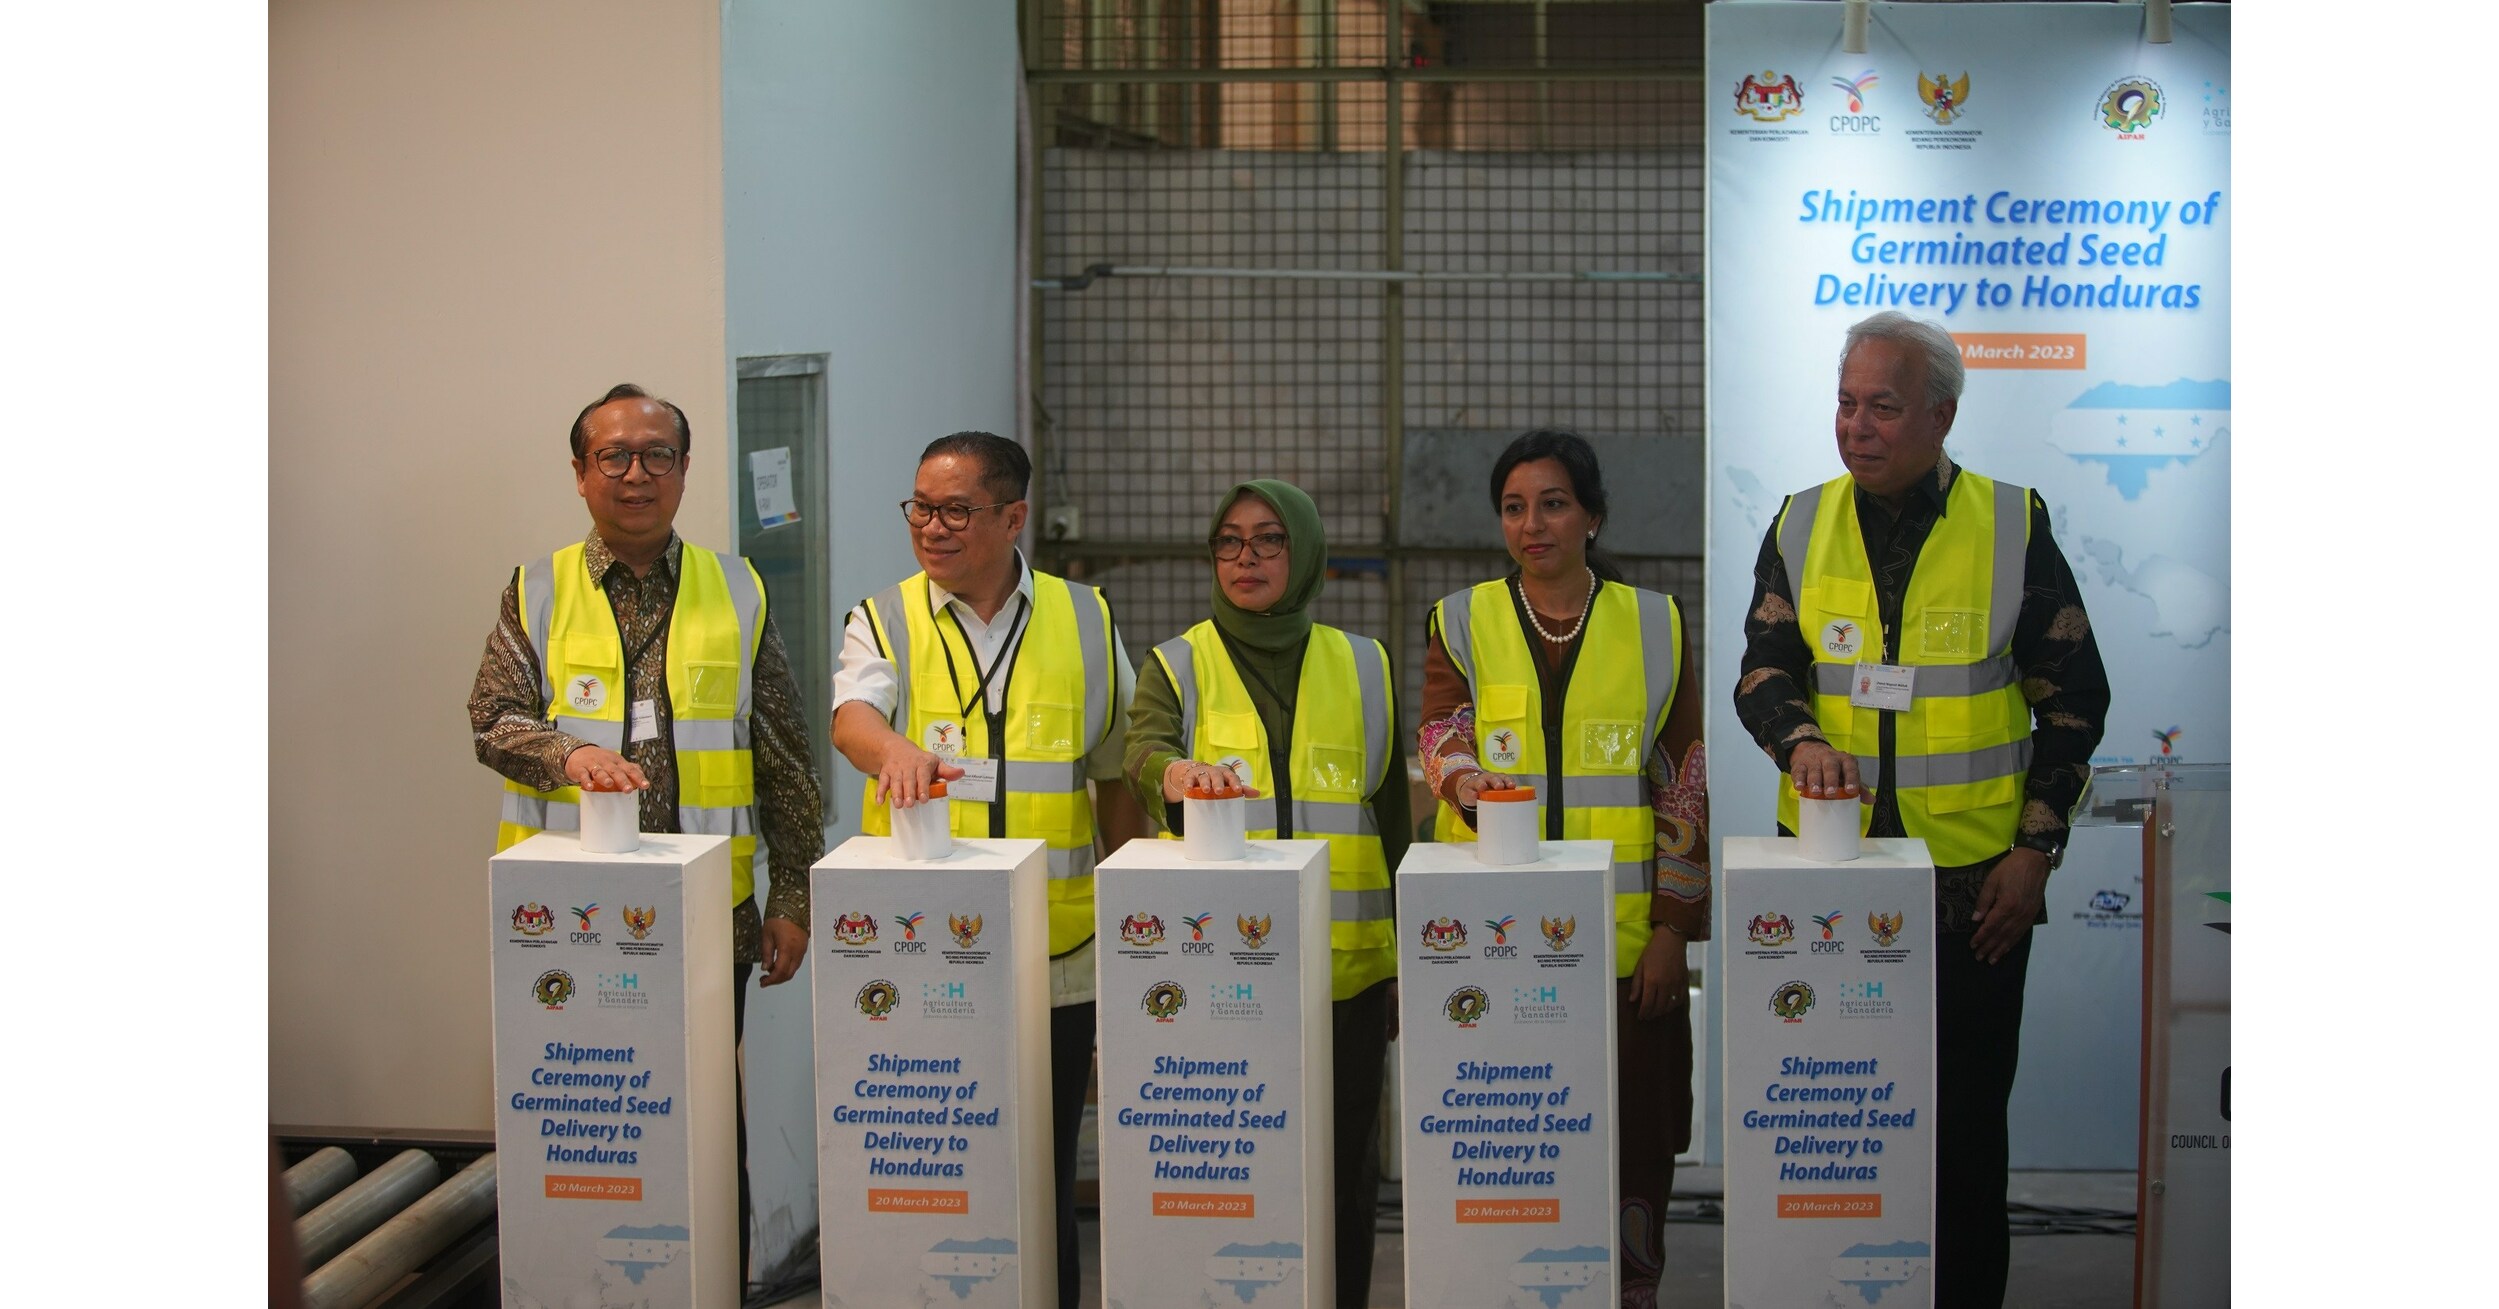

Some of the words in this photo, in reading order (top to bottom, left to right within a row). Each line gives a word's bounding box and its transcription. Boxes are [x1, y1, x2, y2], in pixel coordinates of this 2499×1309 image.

[1830, 116, 1881, 132] CPOPC
[1799, 190, 1977, 230] Shipment
[1986, 191, 2171, 233] Ceremony
[2180, 191, 2221, 226] of
[1851, 232, 2070, 266] Germinated
[2079, 233, 2167, 266] Seed
[1814, 273, 1968, 316] Delivery
[1977, 278, 2011, 308] to
[2021, 275, 2200, 309] Honduras
[1966, 345, 2024, 359] March
[2029, 345, 2075, 359] 2023
[1829, 643, 1852, 652] CPOPC
[575, 697, 597, 707] CPOPC
[933, 743, 955, 751] CPOPC
[1493, 752, 1515, 761] CPOPC
[570, 932, 601, 943] CPOPC
[894, 942, 926, 952] CPOPC
[1811, 941, 1844, 952] CPOPC
[1182, 943, 1214, 953] CPOPC
[1484, 946, 1517, 956] CPOPC
[598, 990, 646, 998] Agricultura
[1840, 1000, 1891, 1008] Agricultura
[544, 1043, 634, 1065] Shipment
[868, 1054, 961, 1076] Shipment
[1154, 1056, 1248, 1078] Shipment
[1456, 1062, 1553, 1084] Shipment
[1780, 1056, 1878, 1079] Shipment
[532, 1068, 625, 1091] Ceremony
[630, 1071, 651, 1088] of
[855, 1080, 951, 1103] Ceremony
[956, 1081, 978, 1099] of
[1140, 1082, 1239, 1106] Ceremony
[1243, 1084, 1265, 1102] of
[1442, 1089, 1543, 1110] Ceremony
[1547, 1087, 1570, 1105] of
[1766, 1084, 1867, 1106] Ceremony
[1871, 1082, 1894, 1101] of
[511, 1093, 622, 1112] Germinated
[626, 1096, 672, 1114] Seed
[833, 1105, 948, 1125] Germinated
[952, 1108, 999, 1125] Seed
[1118, 1108, 1235, 1127] Germinated
[1239, 1110, 1286, 1128] Seed
[1420, 1114, 1539, 1133] Germinated
[1543, 1113, 1592, 1132] Seed
[1743, 1109, 1863, 1128] Germinated
[1867, 1109, 1916, 1127] Seed
[541, 1119, 618, 1142] Delivery
[623, 1123, 642, 1138] to
[864, 1132, 944, 1155] Delivery
[949, 1135, 968, 1150] to
[1149, 1135, 1230, 1158] Delivery
[1235, 1138, 1255, 1154] to
[1775, 1135, 1858, 1158] Delivery
[1862, 1138, 1883, 1153] to
[2172, 1135, 2217, 1148] COUNCIL
[547, 1145, 637, 1164] Honduras
[1452, 1141, 1535, 1163] Delivery
[1539, 1142, 1560, 1158] to
[869, 1157, 963, 1176] Honduras
[1154, 1161, 1250, 1180] Honduras
[1457, 1167, 1555, 1185] Honduras
[1780, 1162, 1877, 1181] Honduras
[552, 1183, 565, 1191] 20
[568, 1183, 604, 1193] March
[607, 1185, 635, 1194] 2023
[876, 1197, 890, 1205] 20
[892, 1197, 929, 1206] March
[932, 1198, 961, 1207] 2023
[1160, 1201, 1174, 1209] 20
[1177, 1201, 1214, 1210] March
[1218, 1202, 1247, 1210] 2023
[1464, 1208, 1478, 1216] 20
[1481, 1208, 1518, 1216] March
[1522, 1207, 1552, 1216] 2023
[1785, 1202, 1799, 1211] 20
[1802, 1202, 1840, 1211] March
[1844, 1202, 1873, 1211] 2023
